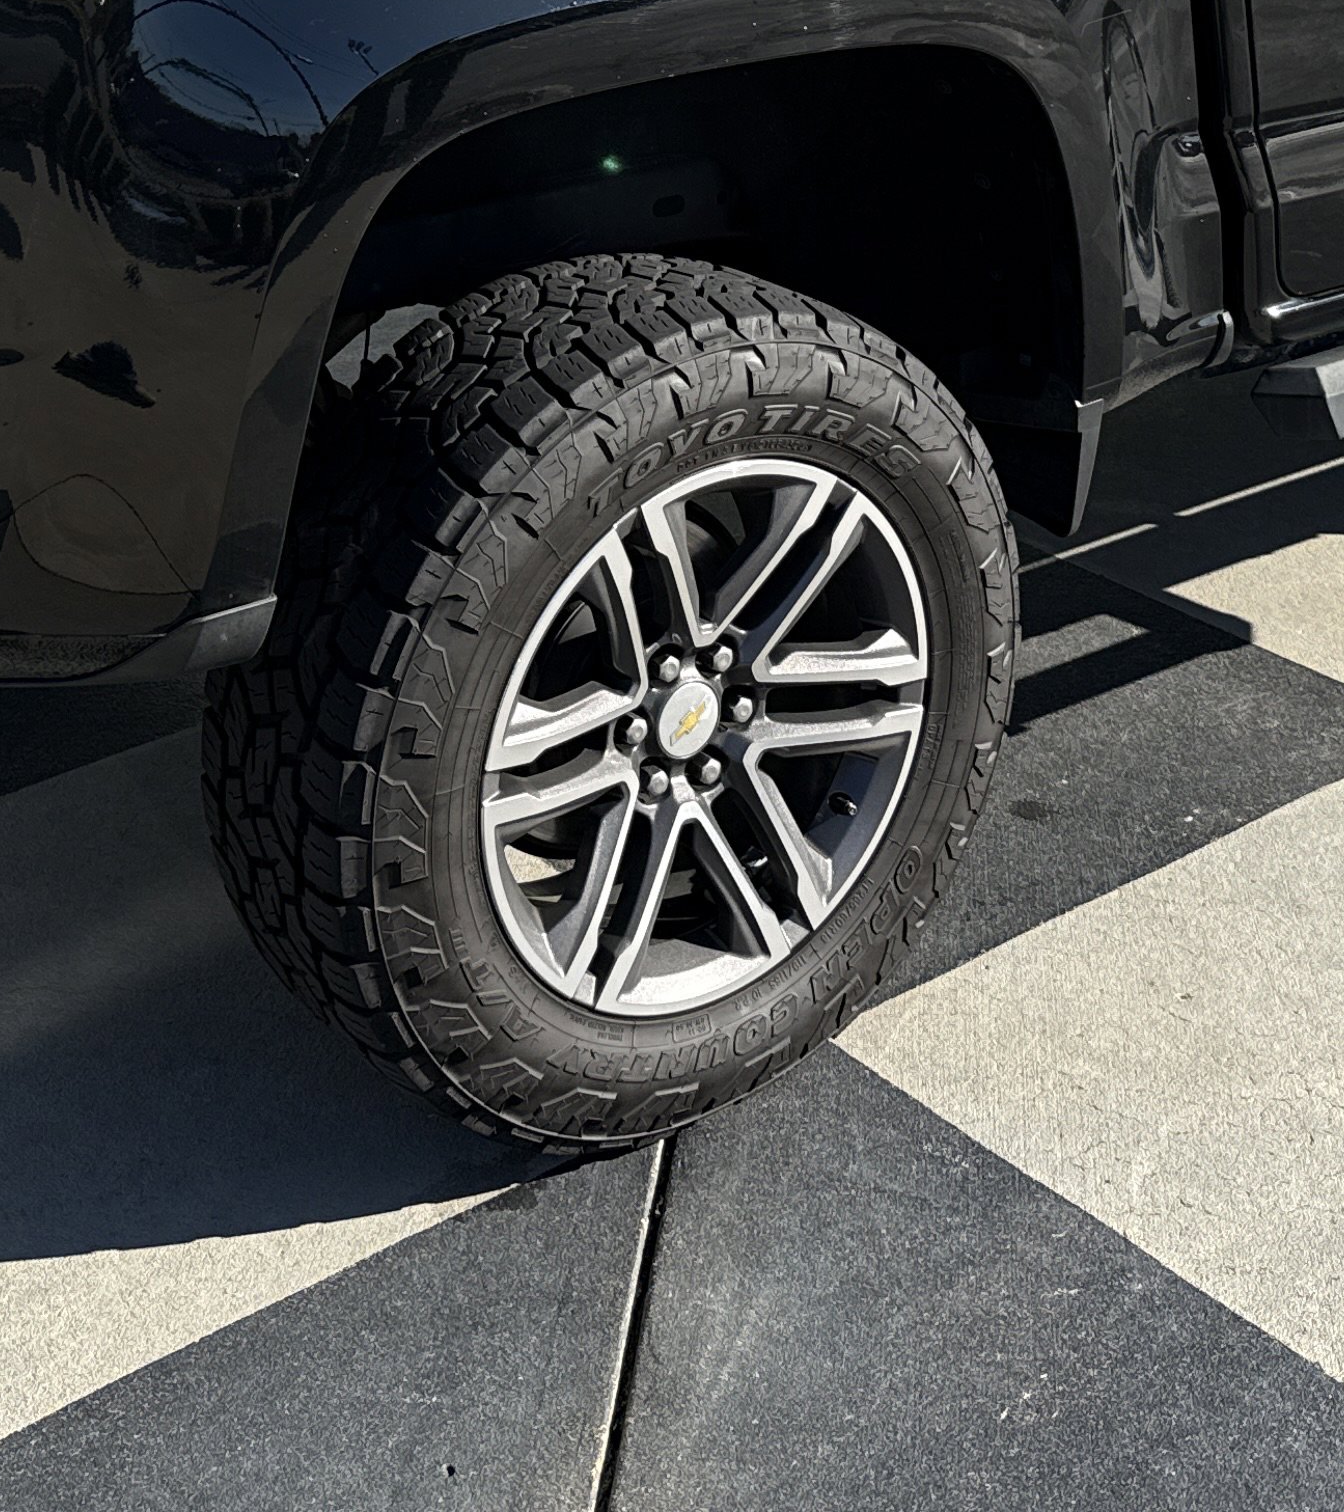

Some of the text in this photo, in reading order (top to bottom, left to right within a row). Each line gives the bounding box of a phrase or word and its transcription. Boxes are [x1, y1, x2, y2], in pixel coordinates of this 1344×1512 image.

[587, 407, 748, 518] TOYO
[757, 404, 922, 479] TIRES
[810, 845, 923, 1005] OPEN
[546, 993, 800, 1083] COUNTRY
